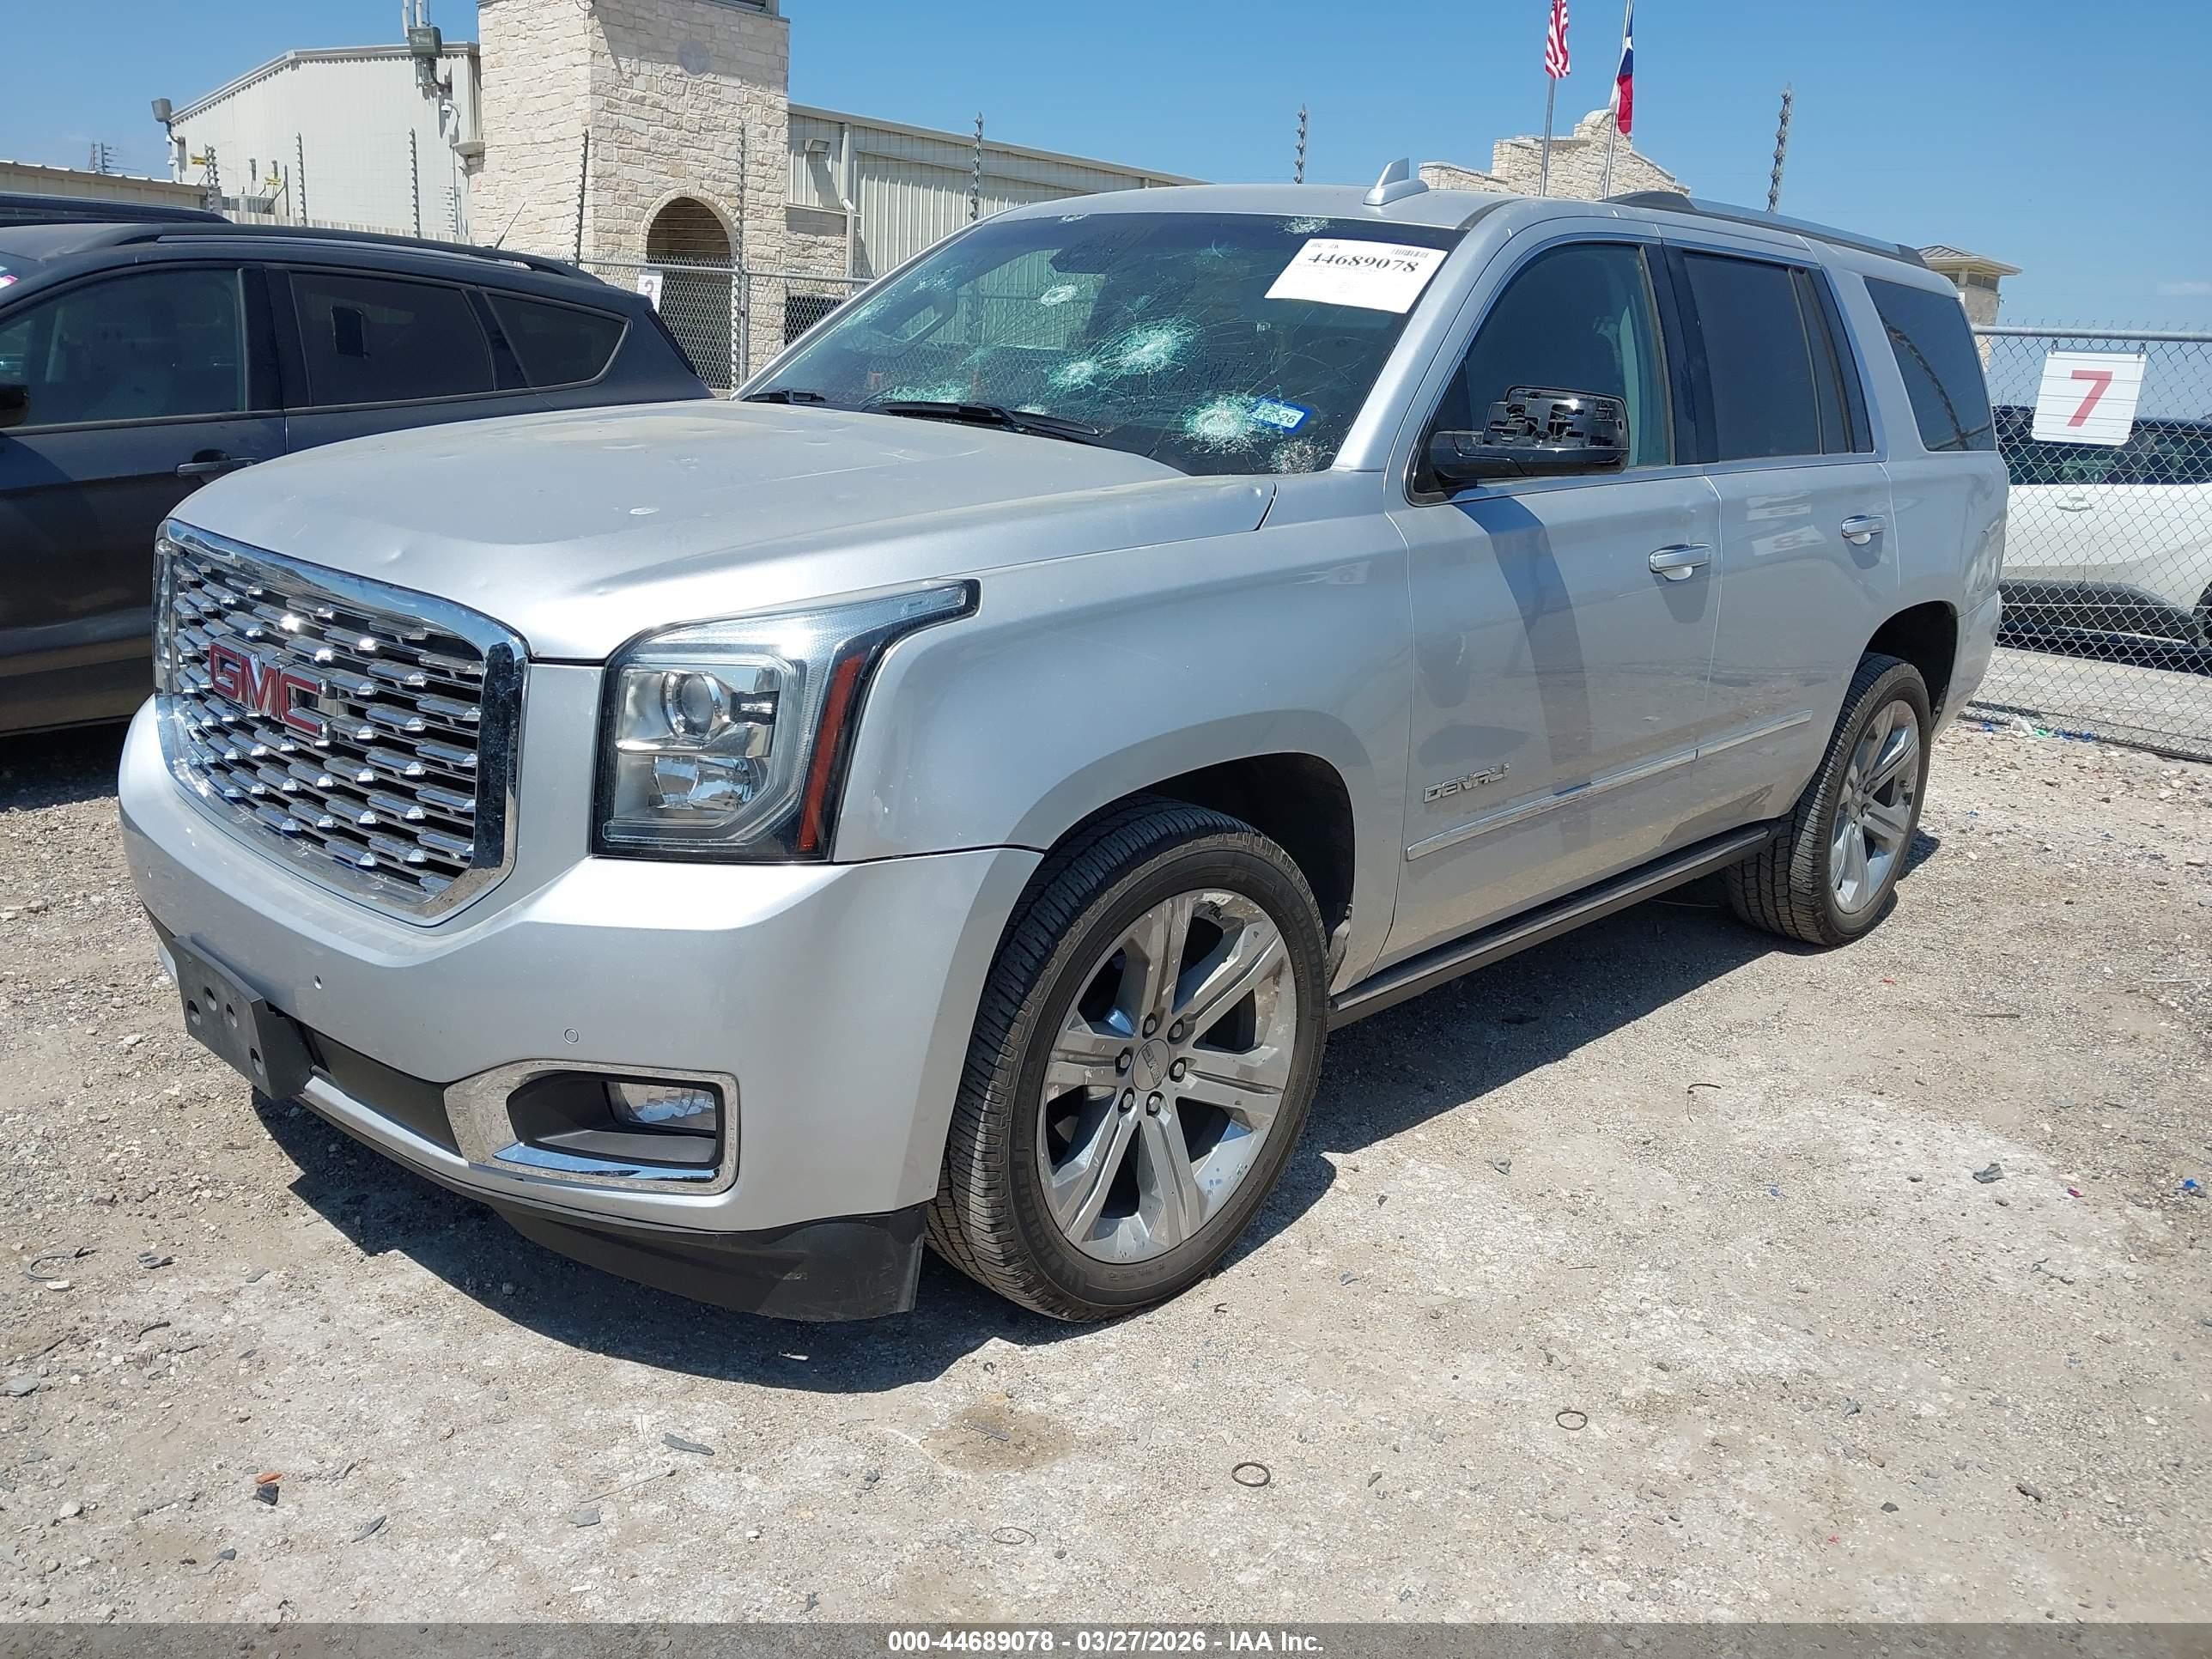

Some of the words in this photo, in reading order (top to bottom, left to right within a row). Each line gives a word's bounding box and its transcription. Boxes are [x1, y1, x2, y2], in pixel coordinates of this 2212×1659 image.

[1308, 252, 1419, 273] 44689078
[1281, 412, 1297, 424] 26
[2066, 369, 2114, 428] 7
[209, 644, 325, 739] GMC
[1424, 763, 1510, 803] DENALI
